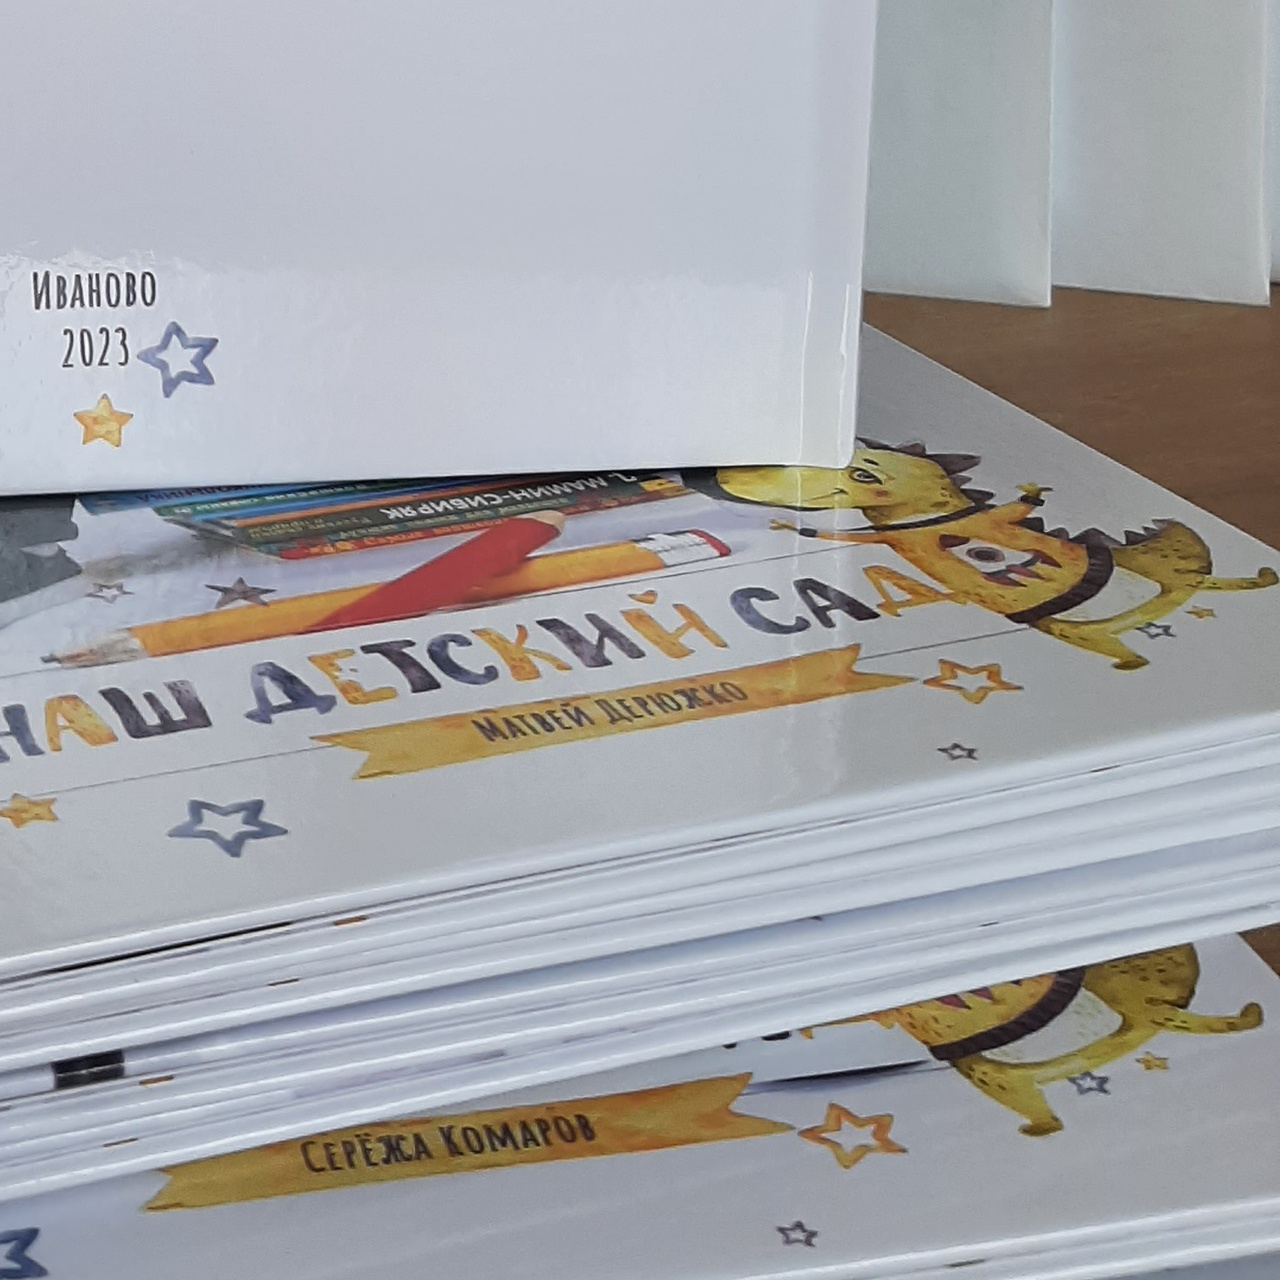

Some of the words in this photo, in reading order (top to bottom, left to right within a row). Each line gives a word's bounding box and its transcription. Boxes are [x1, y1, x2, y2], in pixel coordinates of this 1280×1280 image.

[32, 270, 157, 310] ИВАНОВО
[62, 327, 130, 368] 2023
[243, 589, 729, 724] ДЕТСКИЙ
[730, 564, 953, 635] САД
[471, 701, 596, 743] МАТВЕЙ
[594, 681, 749, 726] ДЕРЮЖКО
[437, 1112, 598, 1160] КОМАРОВ
